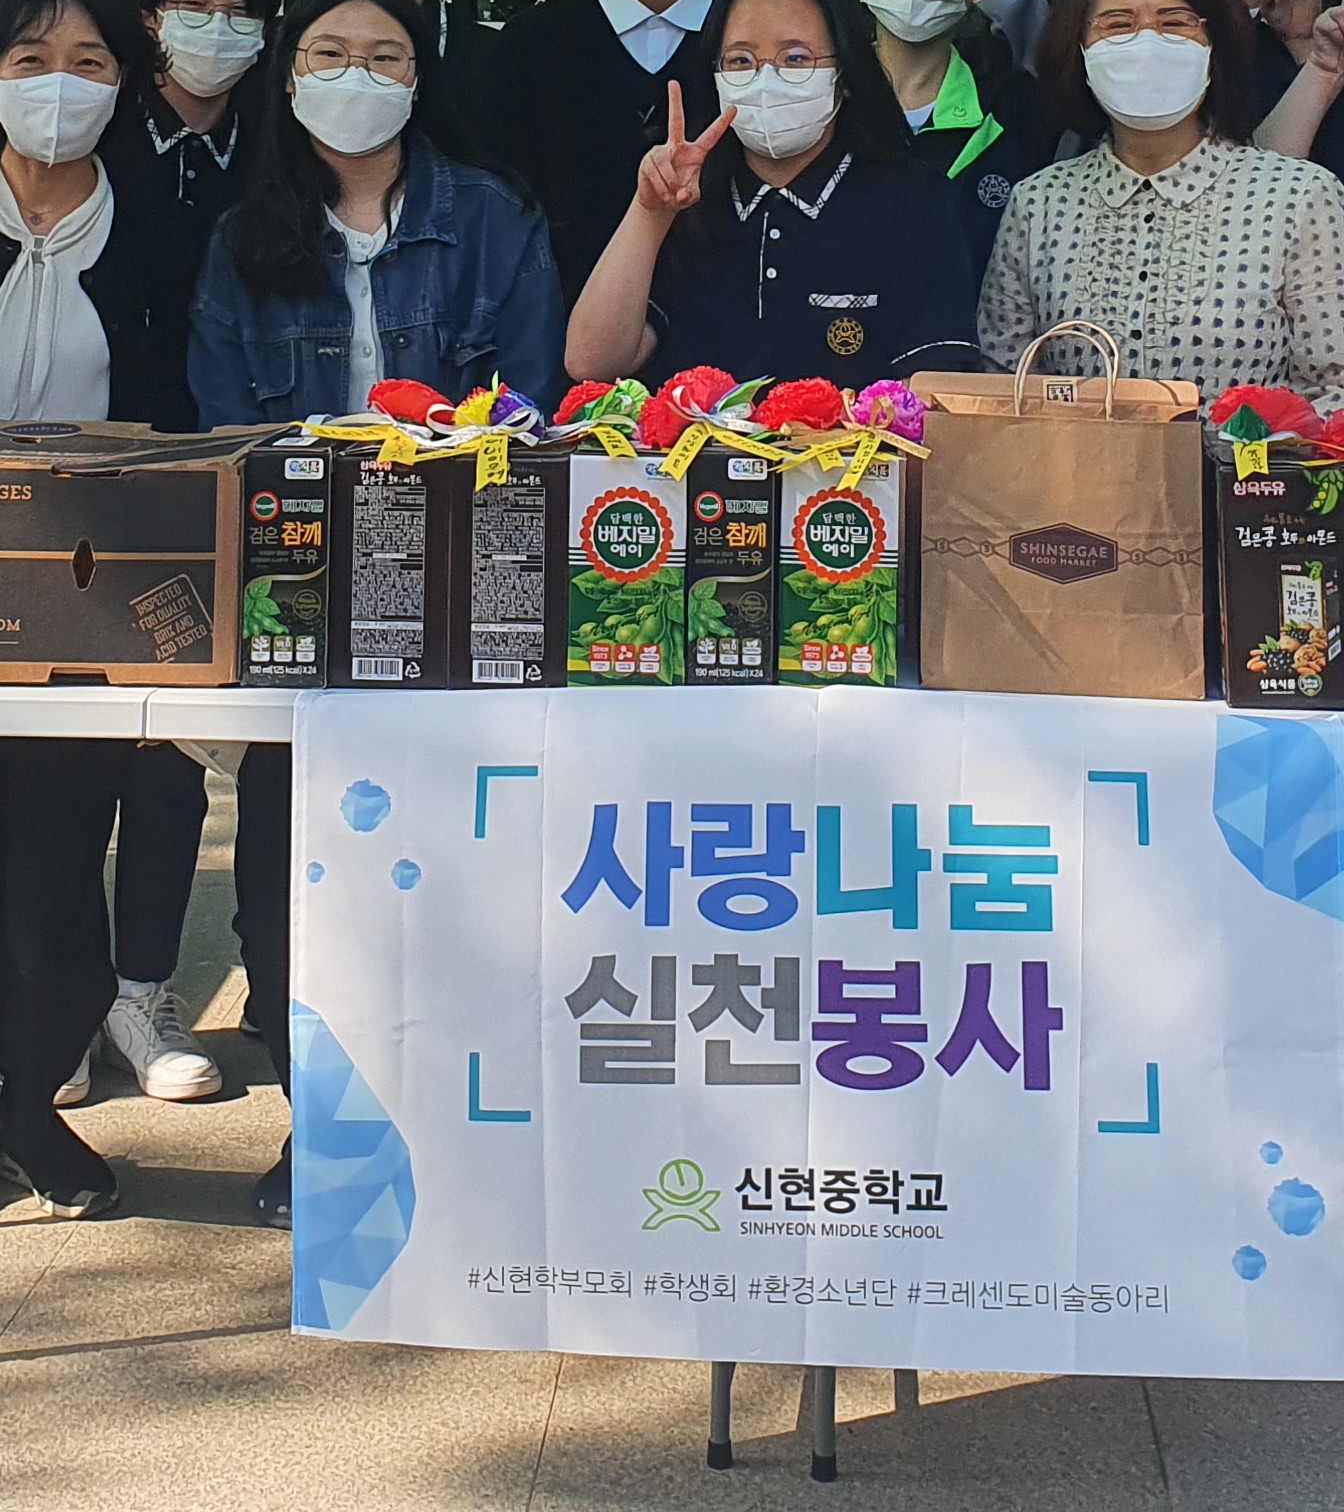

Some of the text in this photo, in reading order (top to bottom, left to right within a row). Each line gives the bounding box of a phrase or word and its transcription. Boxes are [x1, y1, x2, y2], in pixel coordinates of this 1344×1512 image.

[1233, 480, 1286, 496] 삼육두유
[610, 512, 644, 525] 담백한
[822, 512, 857, 525] 담백한
[249, 521, 322, 546] 검은 참깨
[597, 525, 656, 544] 베지밀
[694, 522, 767, 548] 검은 참깨
[809, 525, 869, 544] 베지밀
[1235, 526, 1277, 548] 검은콩
[1307, 529, 1336, 546] 아몬드
[292, 549, 318, 564] 두유
[610, 544, 642, 558] 에이
[737, 551, 763, 565] 두유
[822, 544, 855, 558] 에이
[1020, 542, 1108, 559] SHINSEGAE
[1031, 557, 1057, 565] FOOD
[136, 583, 182, 616] INSPECTED
[139, 595, 192, 631] FOR QUALITY
[154, 615, 194, 644] BRIX AND
[156, 624, 207, 661] ACID TESTED
[735, 1167, 948, 1215] 신현중학교
[740, 1221, 944, 1239] SINHYEON MIDDLE SCHOOL
[467, 1265, 1169, 1313] #신현학부모회 #학생회 #환경소년단 #크레센도미술동아리
